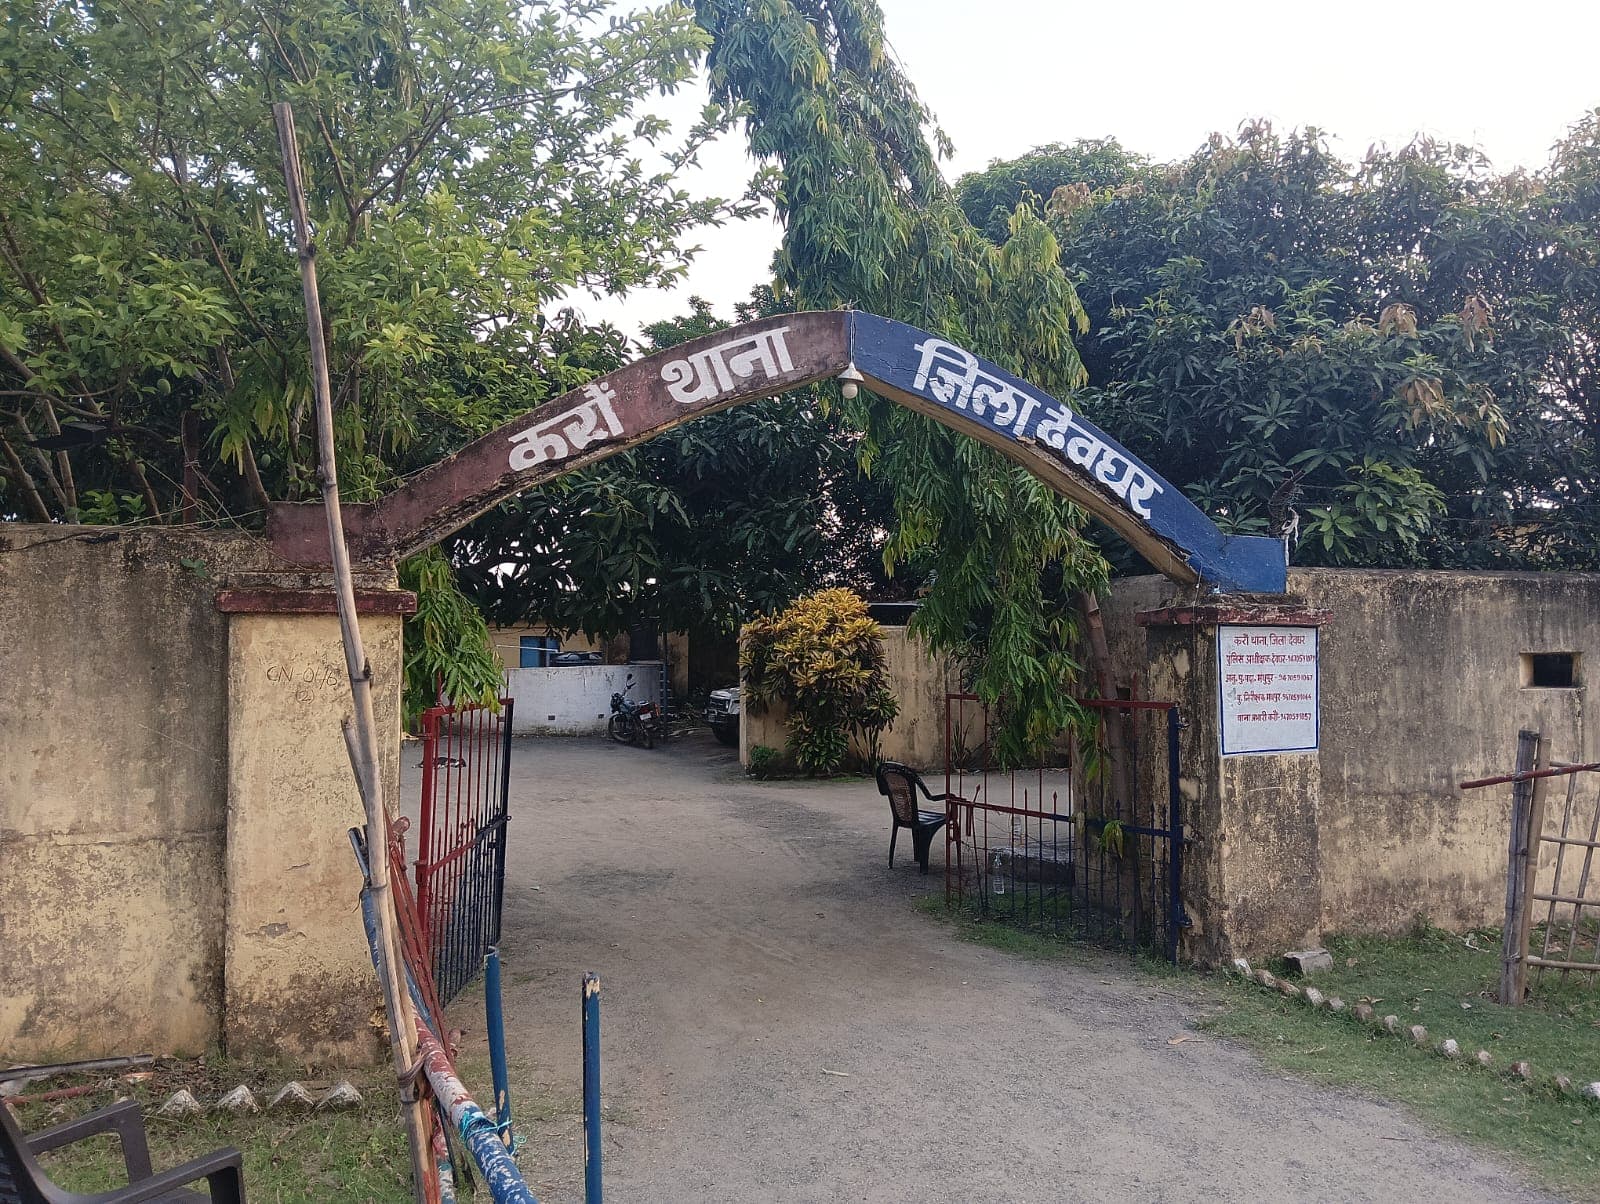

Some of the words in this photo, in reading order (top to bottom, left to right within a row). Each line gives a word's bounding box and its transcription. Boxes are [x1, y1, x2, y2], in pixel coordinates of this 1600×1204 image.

[660, 326, 795, 403] थाना
[913, 338, 1041, 438] जिला
[1036, 404, 1164, 519] देवघर
[1269, 633, 1287, 646] जिला
[1288, 633, 1306, 646] देवघर
[1226, 651, 1245, 666] पुलिस
[1237, 714, 1251, 722] थाना
